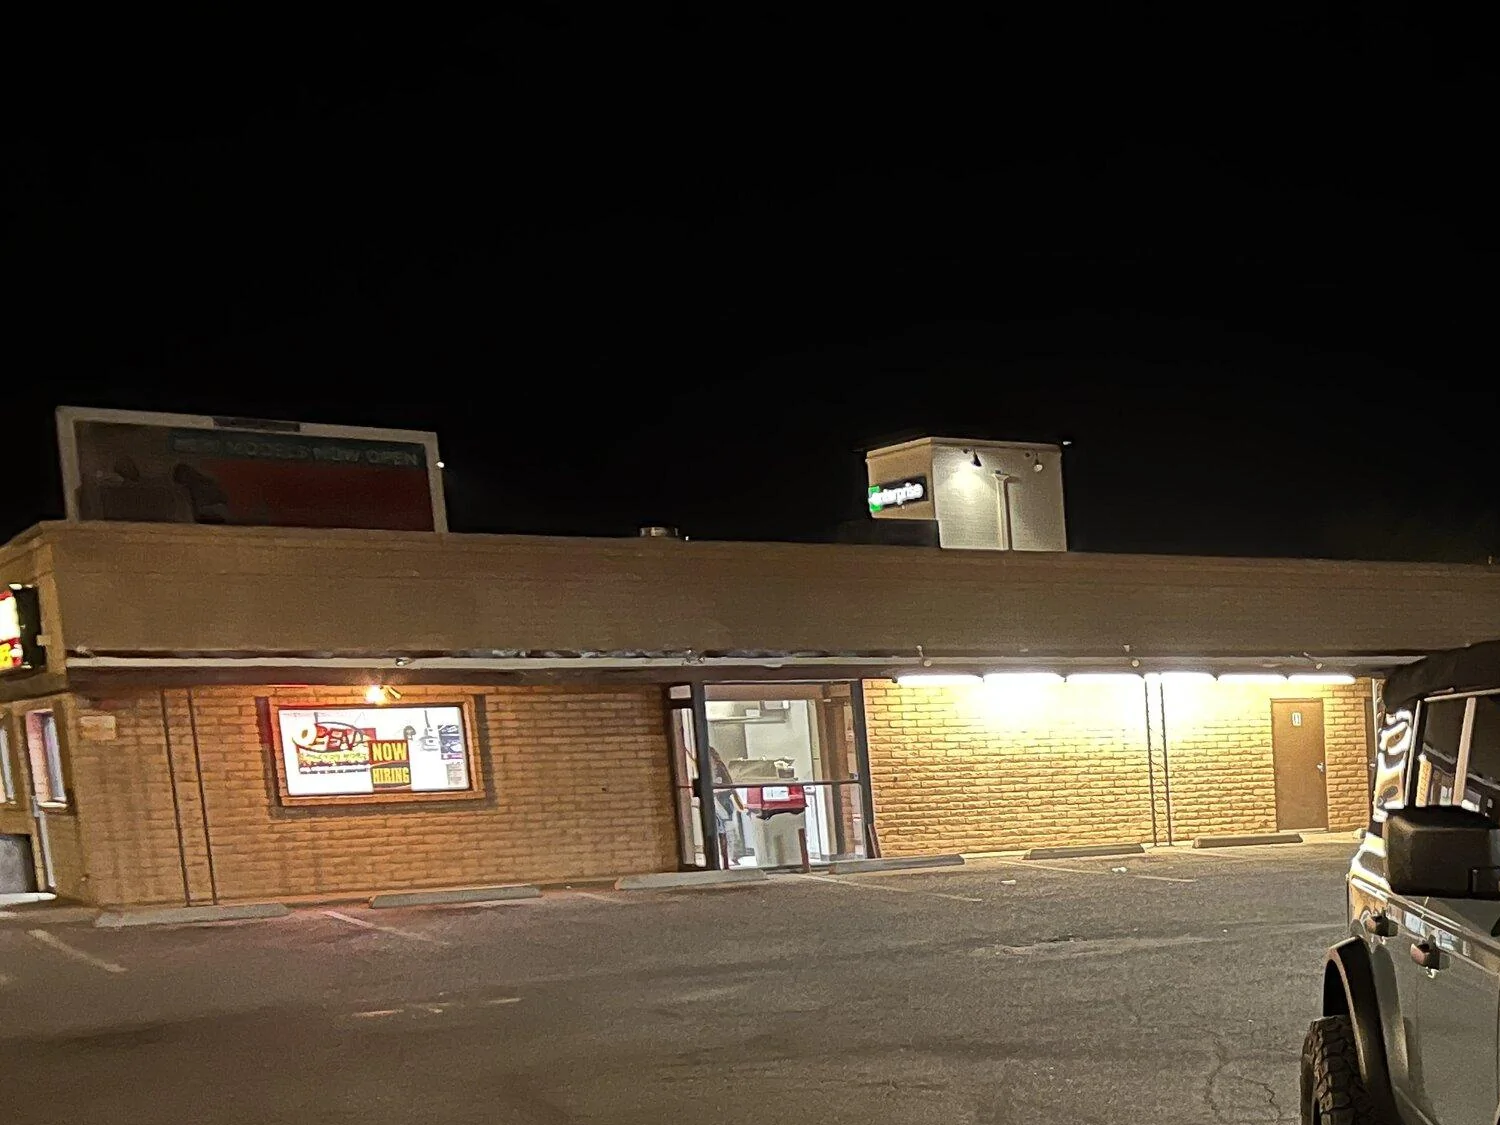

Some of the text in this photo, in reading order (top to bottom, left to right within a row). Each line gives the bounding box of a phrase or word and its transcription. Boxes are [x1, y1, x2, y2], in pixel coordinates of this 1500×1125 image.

[365, 448, 420, 466] OPEN
[372, 742, 407, 761] NOW
[373, 766, 410, 785] HIRING
